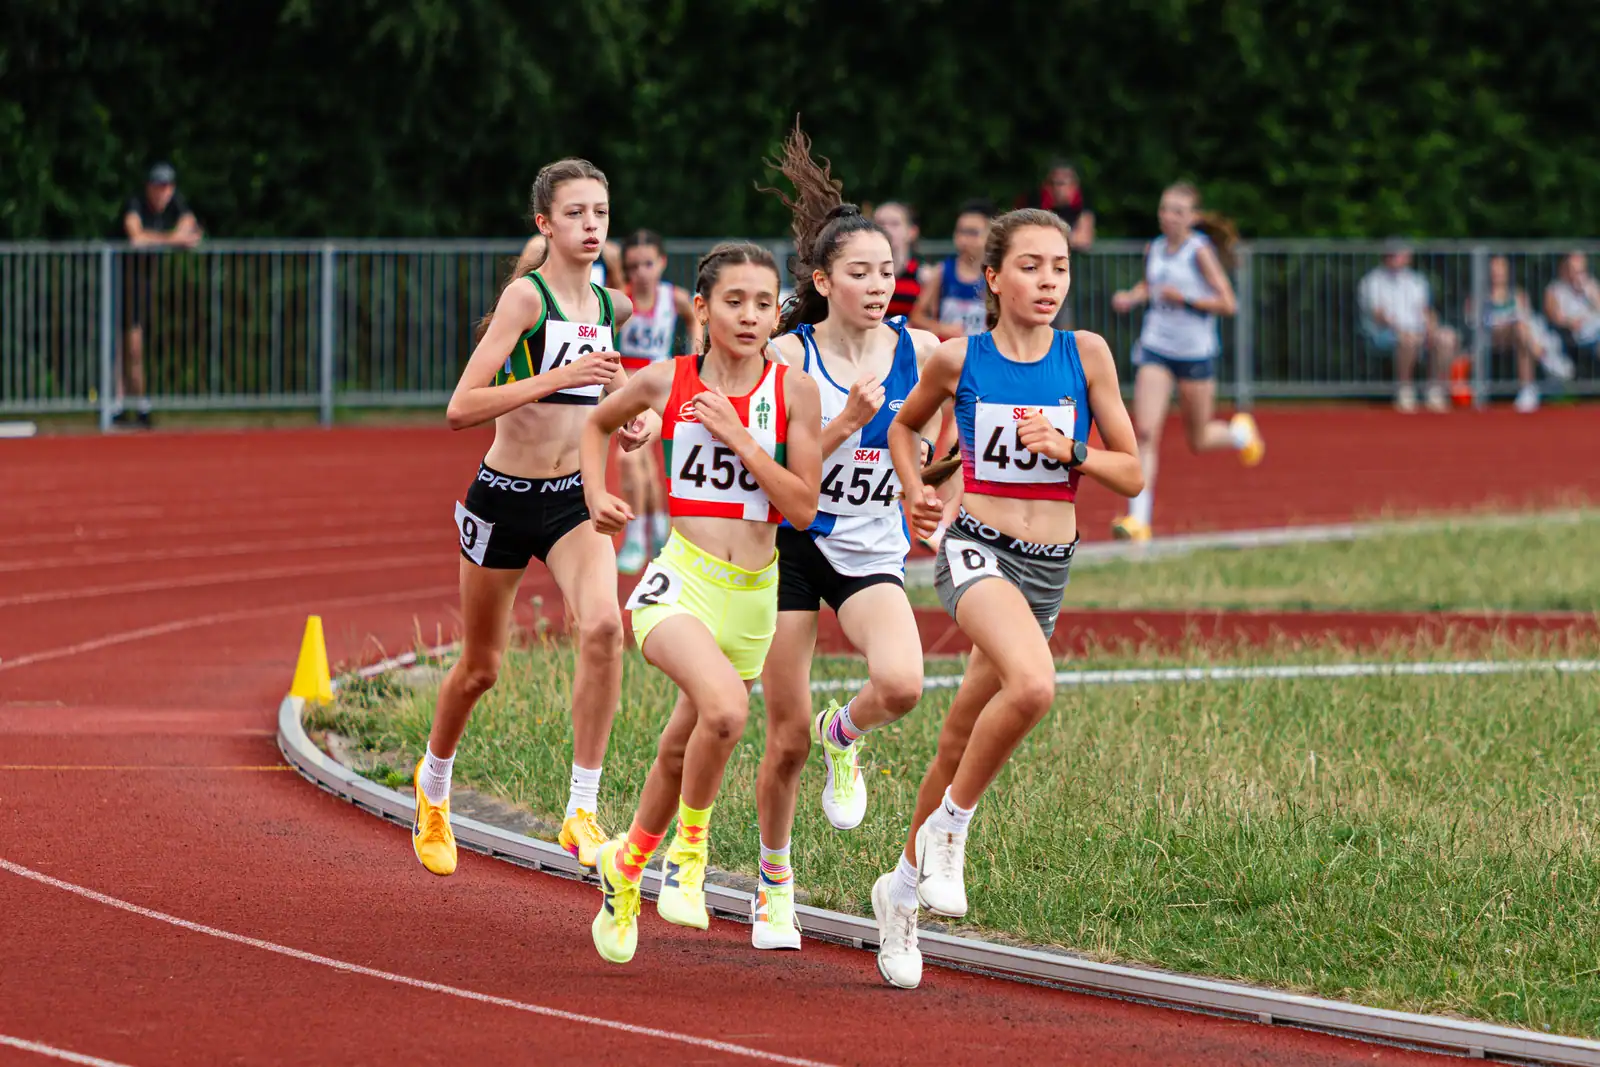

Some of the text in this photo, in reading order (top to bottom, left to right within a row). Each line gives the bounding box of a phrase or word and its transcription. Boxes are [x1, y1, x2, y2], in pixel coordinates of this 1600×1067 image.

[478, 469, 584, 493] PRO NIK
[820, 463, 895, 507] 454
[462, 515, 478, 551] 9
[1009, 538, 1069, 557] NIKE
[692, 556, 738, 587] NIKE
[637, 572, 670, 605] 2
